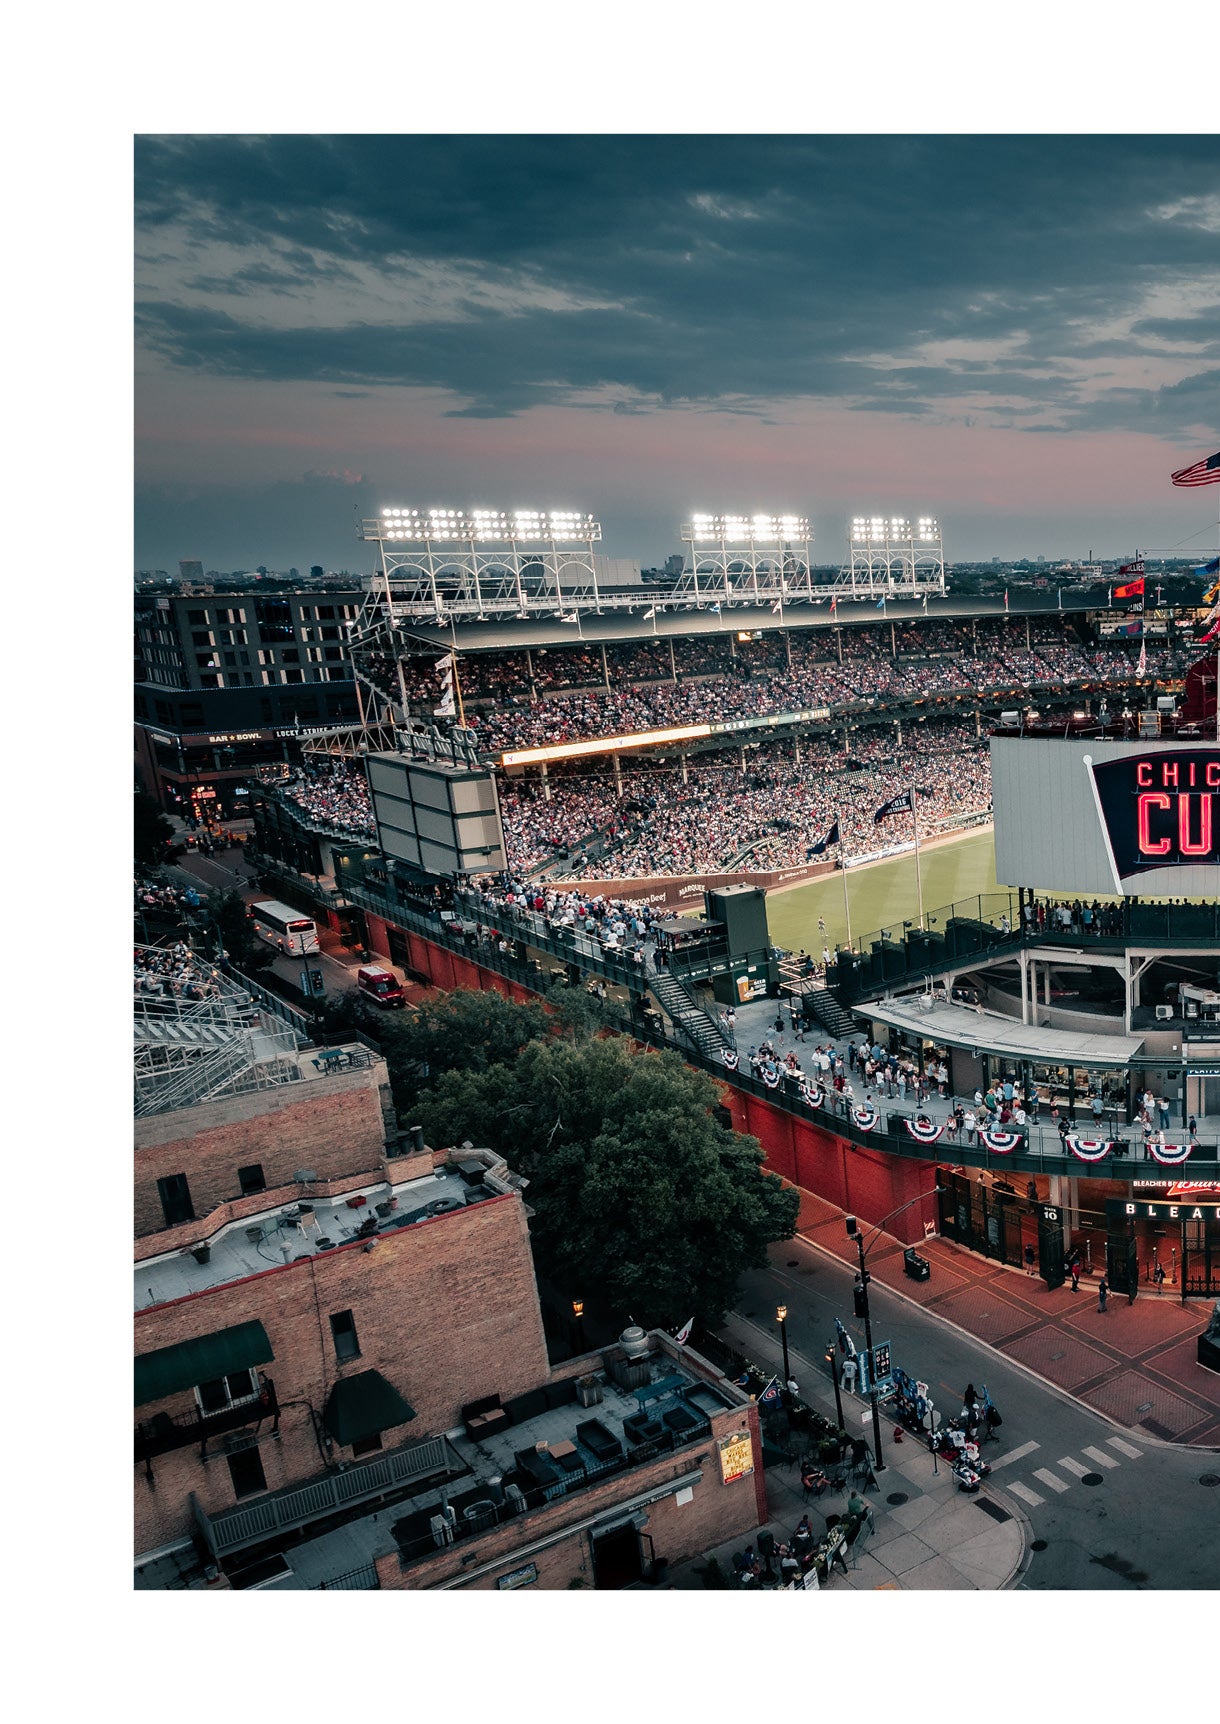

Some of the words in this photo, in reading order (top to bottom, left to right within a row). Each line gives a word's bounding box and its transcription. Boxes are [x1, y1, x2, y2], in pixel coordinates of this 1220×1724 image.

[209, 735, 228, 743] BAR
[236, 732, 262, 741] BOWL
[276, 729, 300, 737] LUCKY
[679, 884, 706, 896] MARQUEE
[650, 892, 666, 902] Beef
[1043, 1211, 1058, 1221] 10
